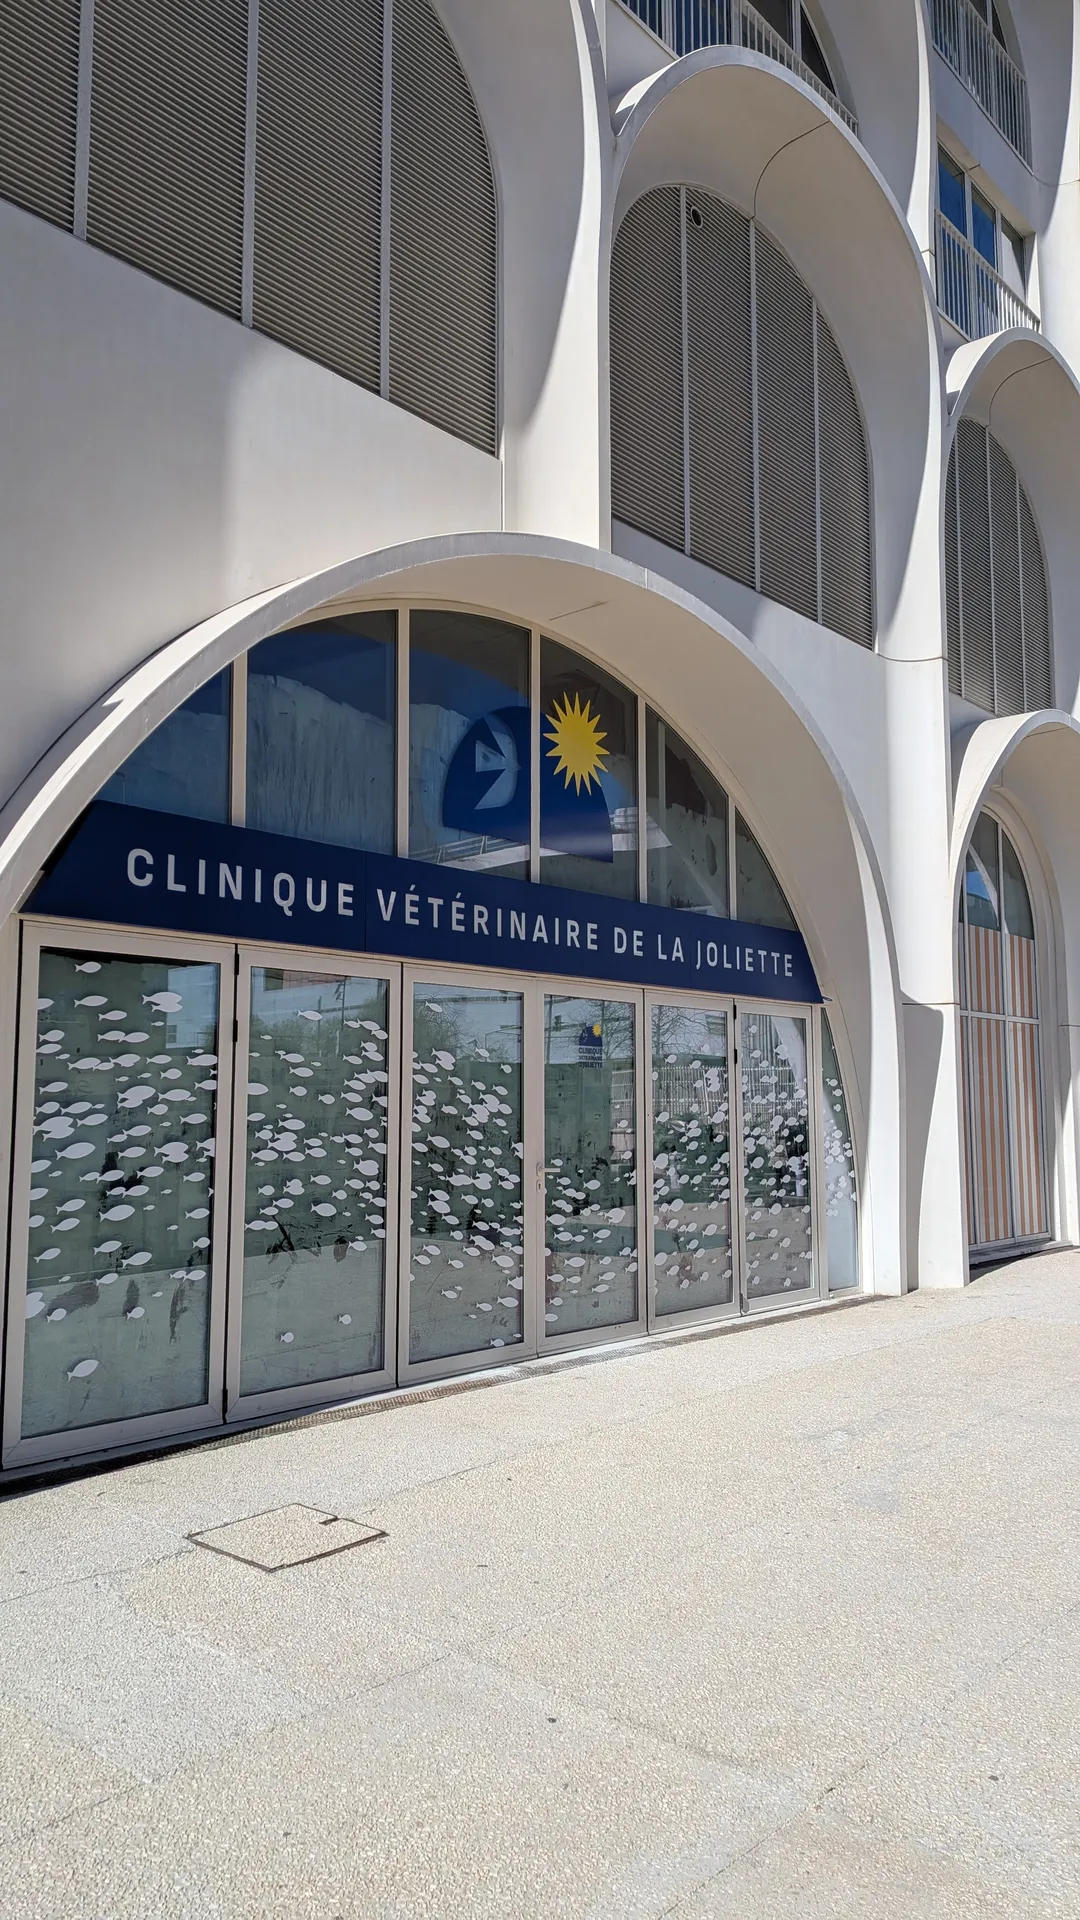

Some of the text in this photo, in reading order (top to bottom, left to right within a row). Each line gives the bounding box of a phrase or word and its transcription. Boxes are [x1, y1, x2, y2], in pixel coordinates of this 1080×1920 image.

[126, 848, 794, 977] CLINIQUE VÉTÉRINAIRE DE LA JOLIETTE
